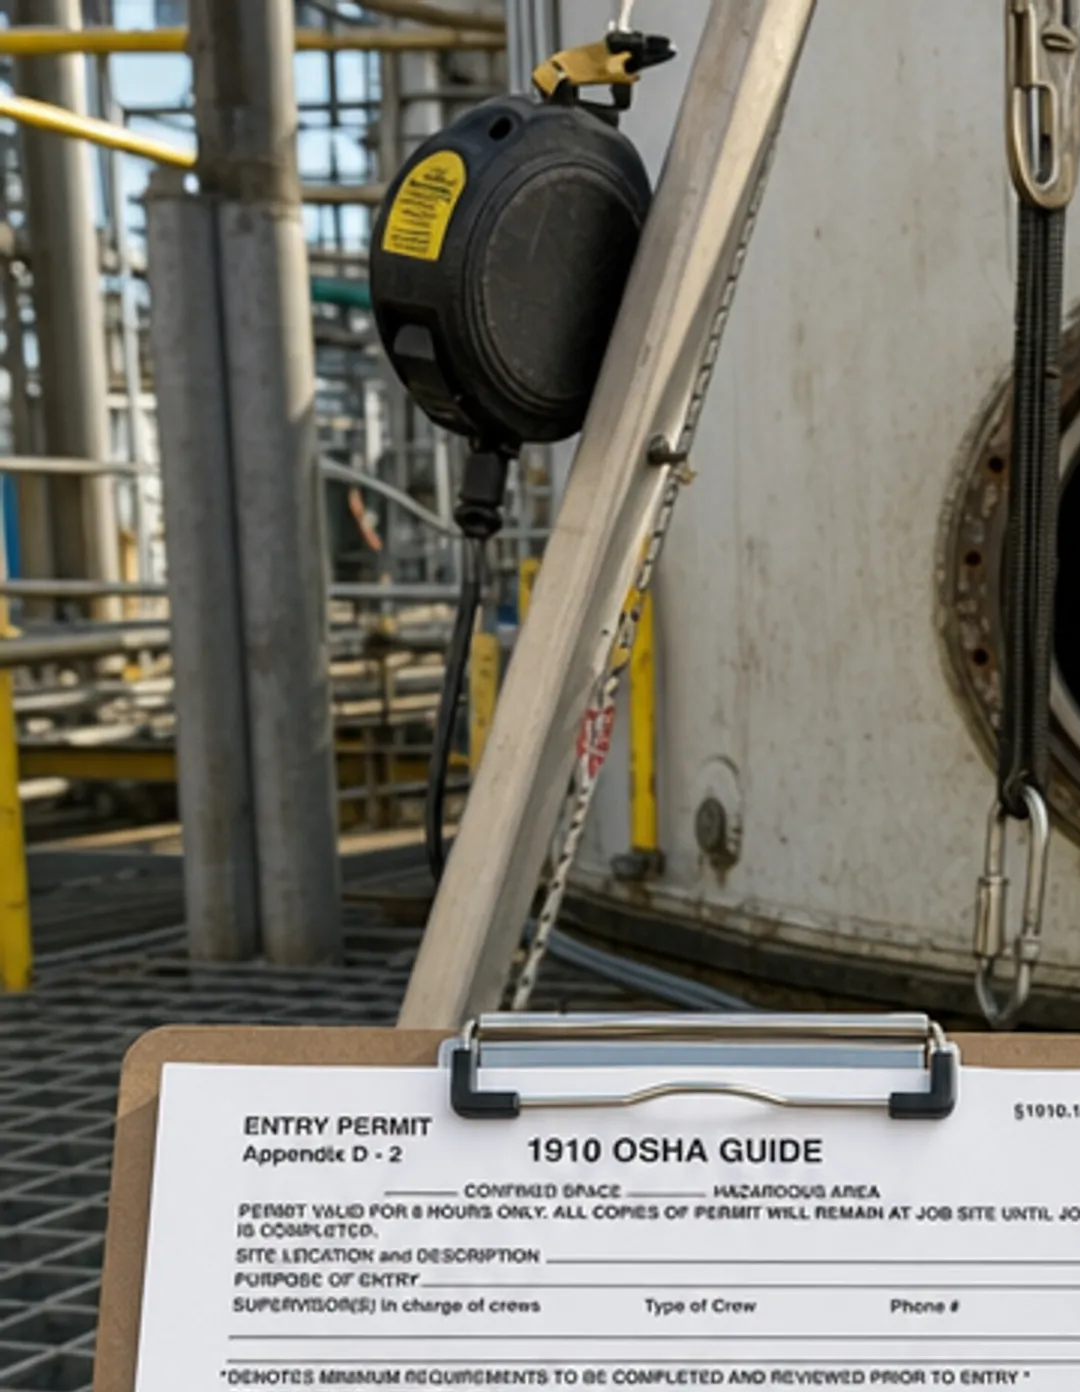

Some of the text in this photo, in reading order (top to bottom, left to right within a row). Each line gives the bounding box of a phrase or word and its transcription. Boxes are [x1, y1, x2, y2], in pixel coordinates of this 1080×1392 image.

[243, 1117, 432, 1136] ENTRY PERMIT
[352, 1147, 368, 1162] D
[389, 1147, 403, 1162] 2
[528, 1138, 823, 1163] 1910 OSHA GUIDE
[553, 1204, 588, 1220] ALL
[767, 1206, 809, 1220] WILL
[889, 1204, 912, 1220] AT
[916, 1204, 952, 1220] JOB
[958, 1204, 995, 1220] SITE
[1002, 1204, 1052, 1220] UNTIL
[379, 1249, 412, 1264] and
[402, 1298, 485, 1314] charge of
[645, 1299, 757, 1316] Type of Crew
[891, 1299, 945, 1313] Phone
[555, 1370, 1018, 1384] TO AND TO ENTRY
